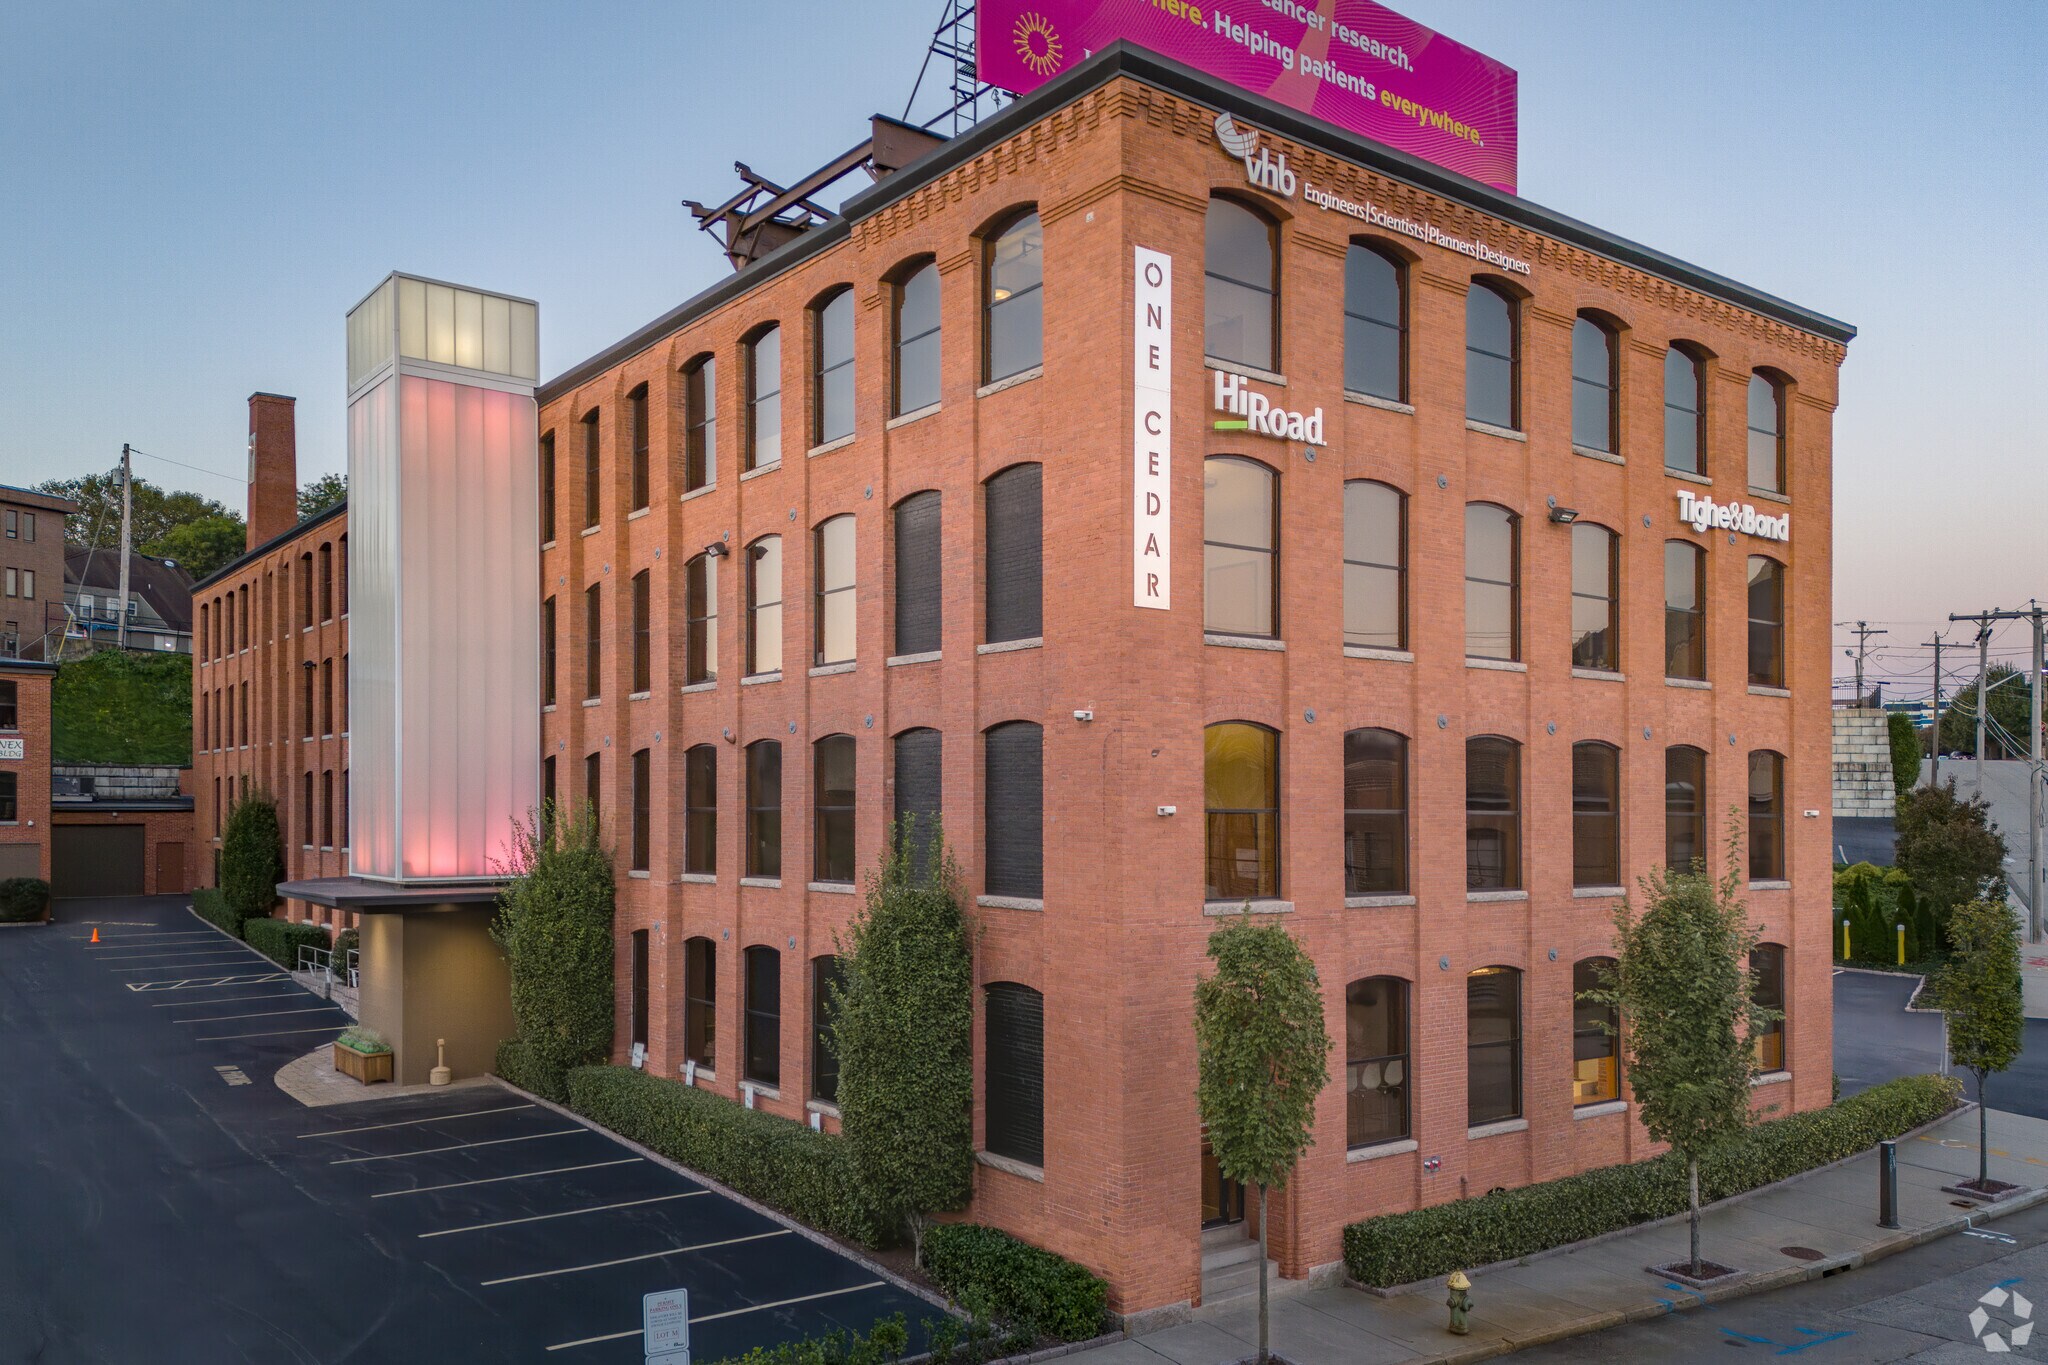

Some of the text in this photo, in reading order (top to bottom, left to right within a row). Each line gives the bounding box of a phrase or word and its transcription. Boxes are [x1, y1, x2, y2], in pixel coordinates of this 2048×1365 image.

[1331, 21, 1414, 73] research.
[1214, 10, 1295, 70] Helping
[1300, 51, 1376, 100] patients
[1380, 88, 1484, 148] everywhere.
[1245, 148, 1296, 197] vhb
[1144, 262, 1163, 598] ONE CEDAR
[1677, 489, 1790, 542] Tighe&Bond
[656, 1331, 669, 1340] LOT
